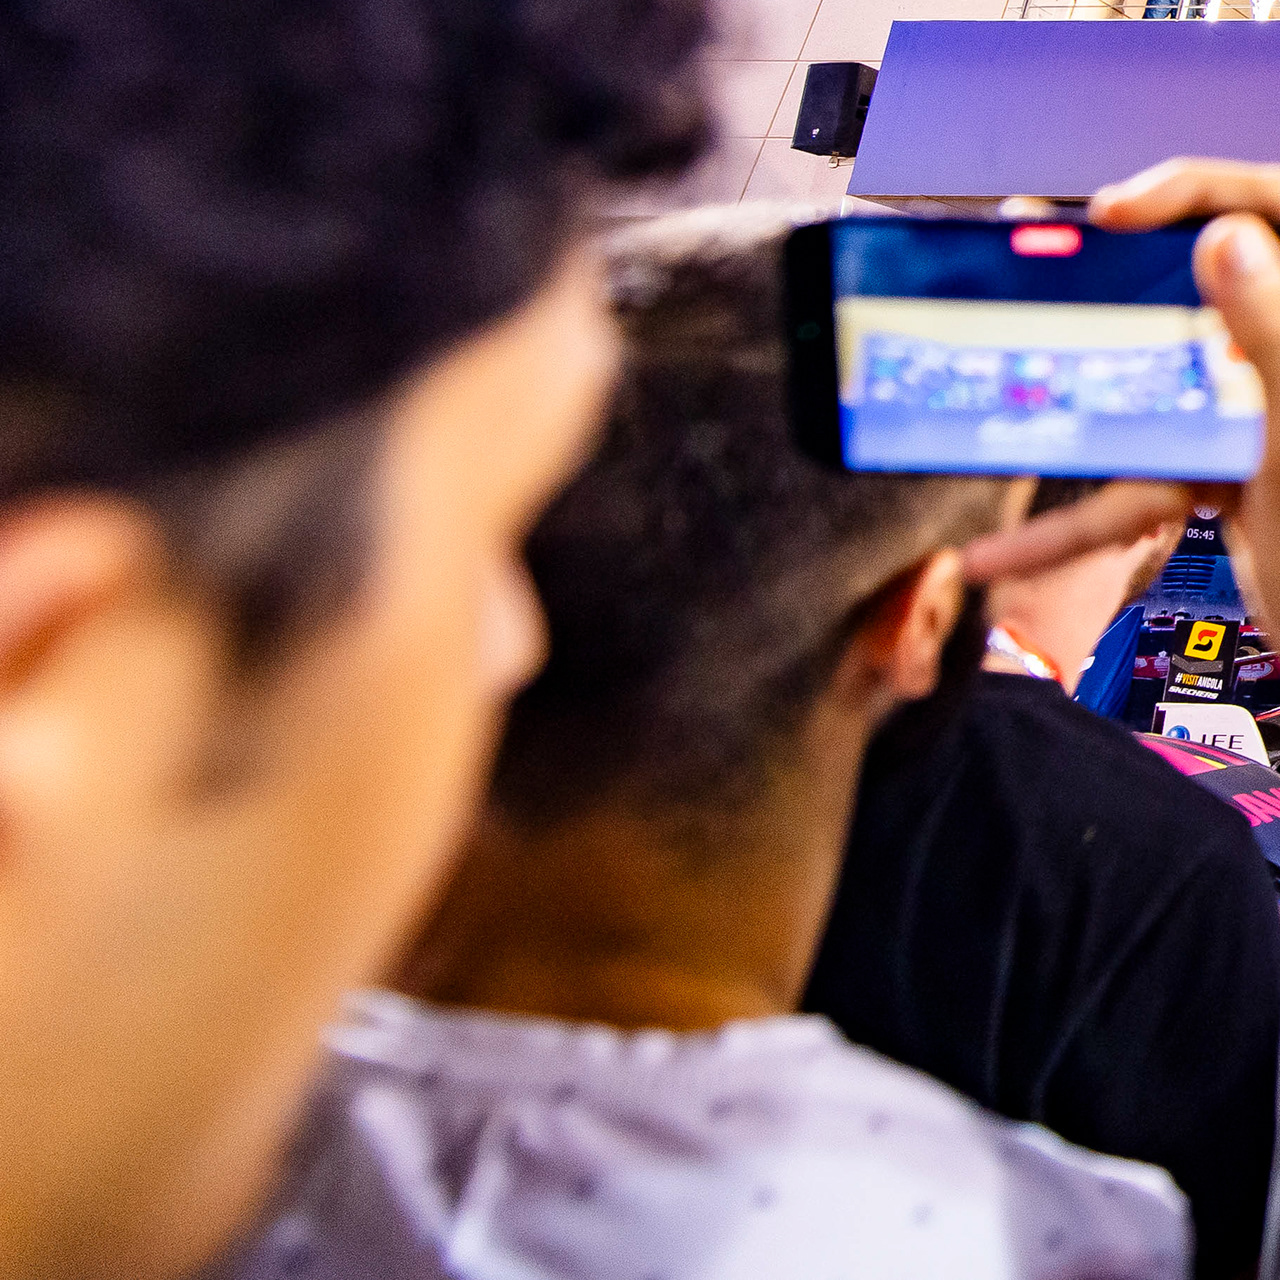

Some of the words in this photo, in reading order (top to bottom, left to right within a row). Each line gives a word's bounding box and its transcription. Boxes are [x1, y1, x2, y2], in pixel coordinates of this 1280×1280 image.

[1186, 527, 1215, 541] 05:45
[1174, 672, 1224, 690] #VISITANGOLA
[1168, 685, 1219, 700] SKECHERS
